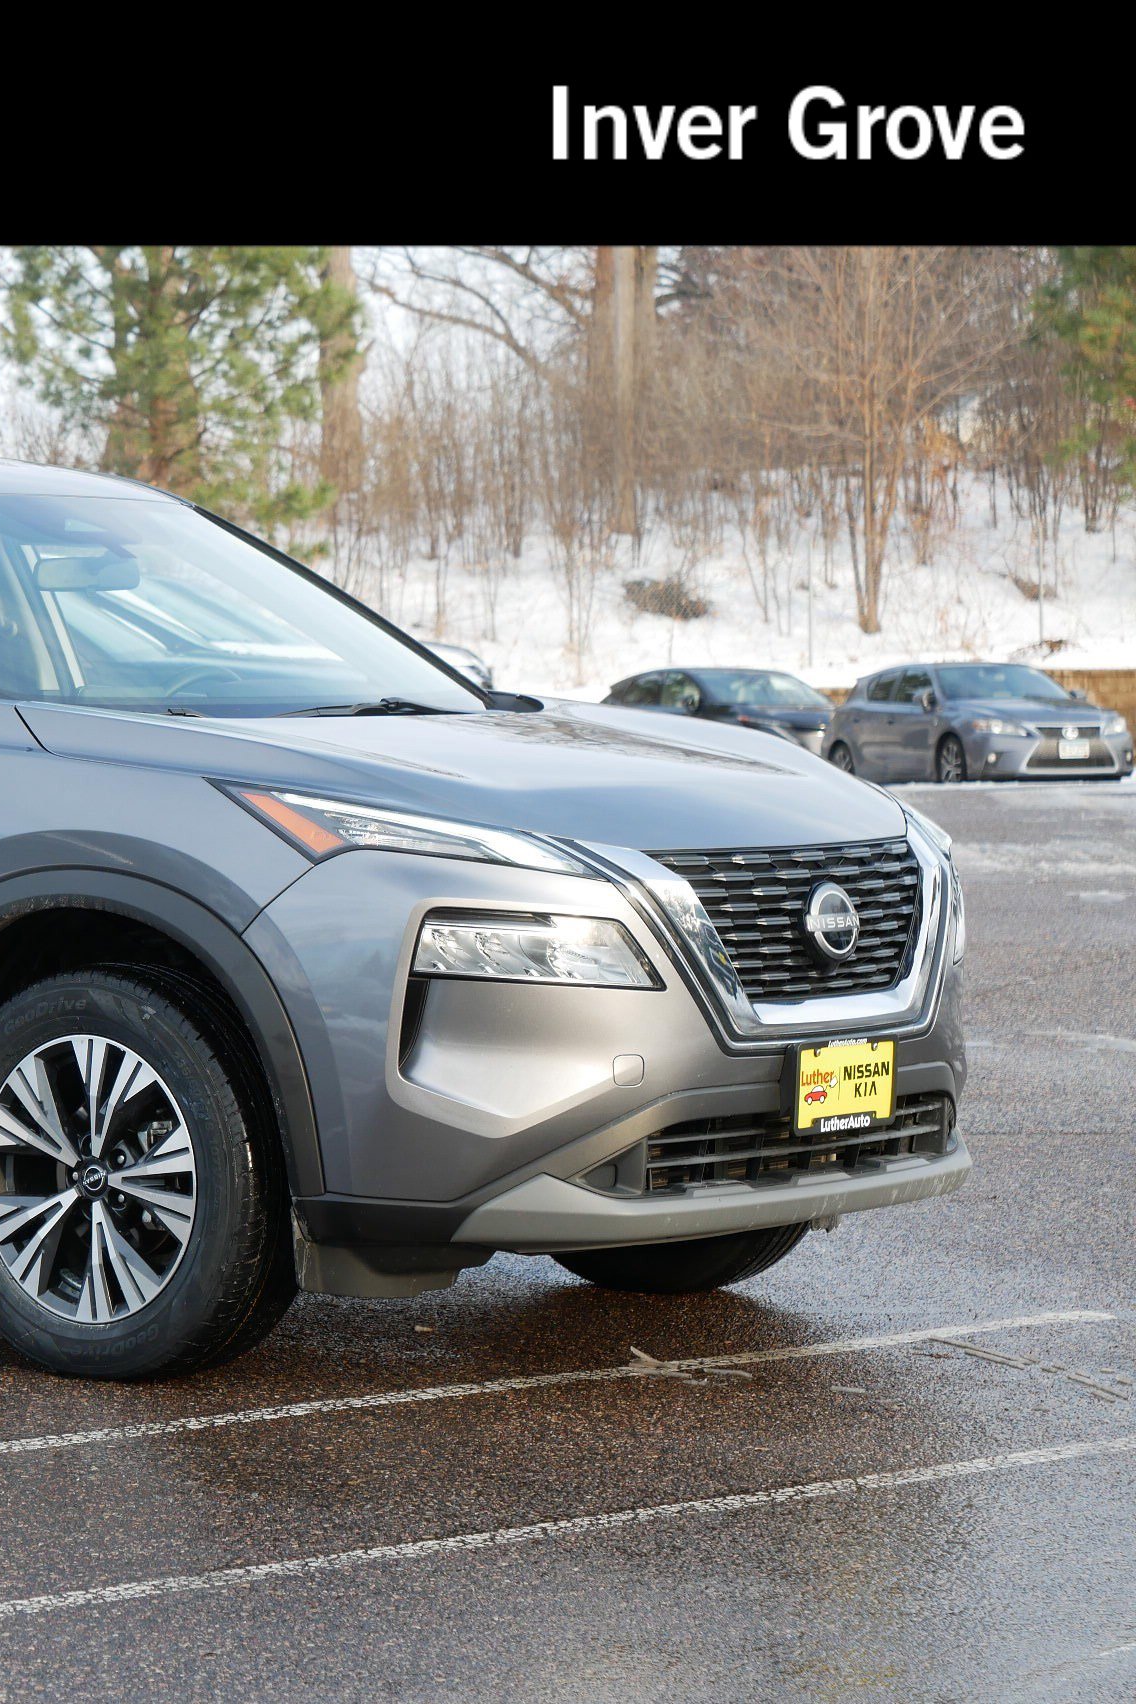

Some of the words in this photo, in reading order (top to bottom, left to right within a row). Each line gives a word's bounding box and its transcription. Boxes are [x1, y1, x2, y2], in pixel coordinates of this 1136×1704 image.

[807, 914, 860, 929] NISSAN
[801, 1068, 835, 1087] Luther
[843, 1061, 890, 1081] NISSAN
[854, 1081, 878, 1098] KIA
[820, 1114, 871, 1133] LutherAuto
[83, 1171, 106, 1185] NISSAN
